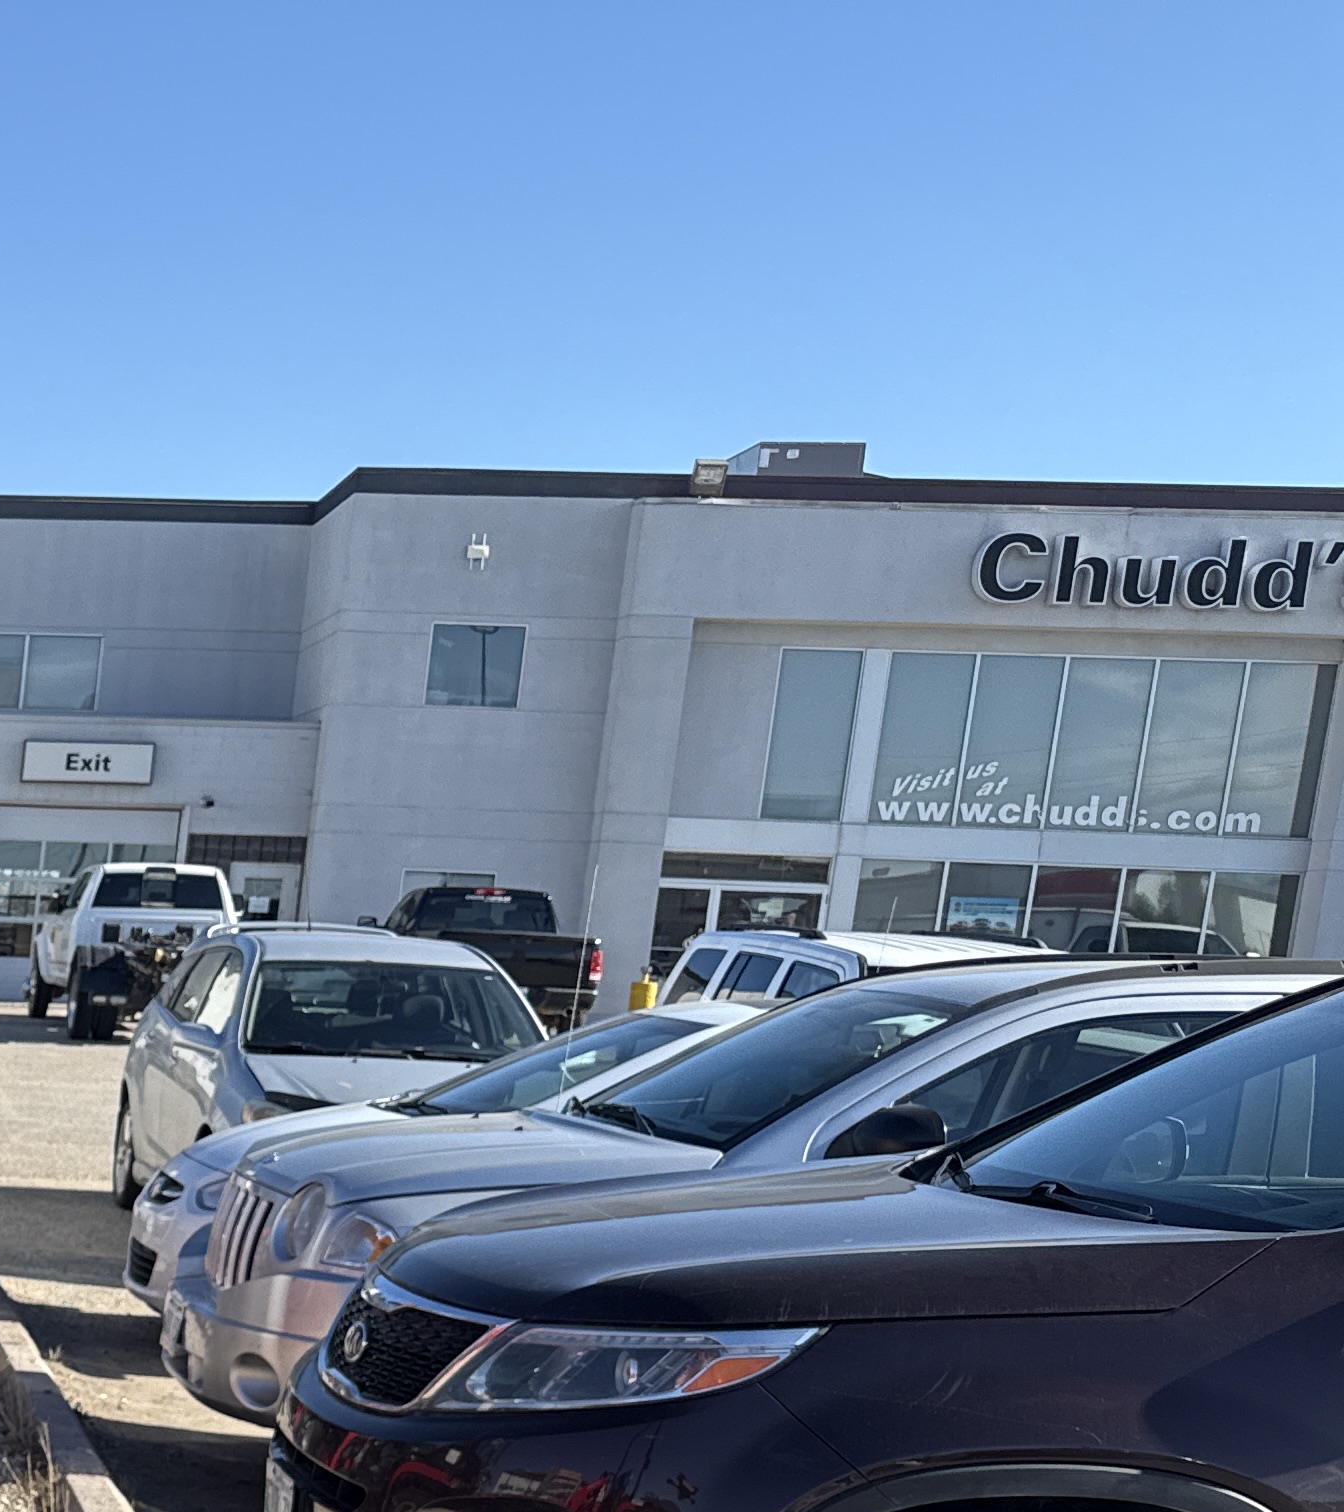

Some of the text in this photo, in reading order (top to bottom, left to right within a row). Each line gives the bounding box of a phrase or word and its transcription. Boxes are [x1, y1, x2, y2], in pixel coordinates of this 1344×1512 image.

[972, 531, 1344, 611] Chudd'
[65, 753, 112, 772] Exit
[892, 760, 999, 797] Visit us
[975, 776, 1009, 797] at
